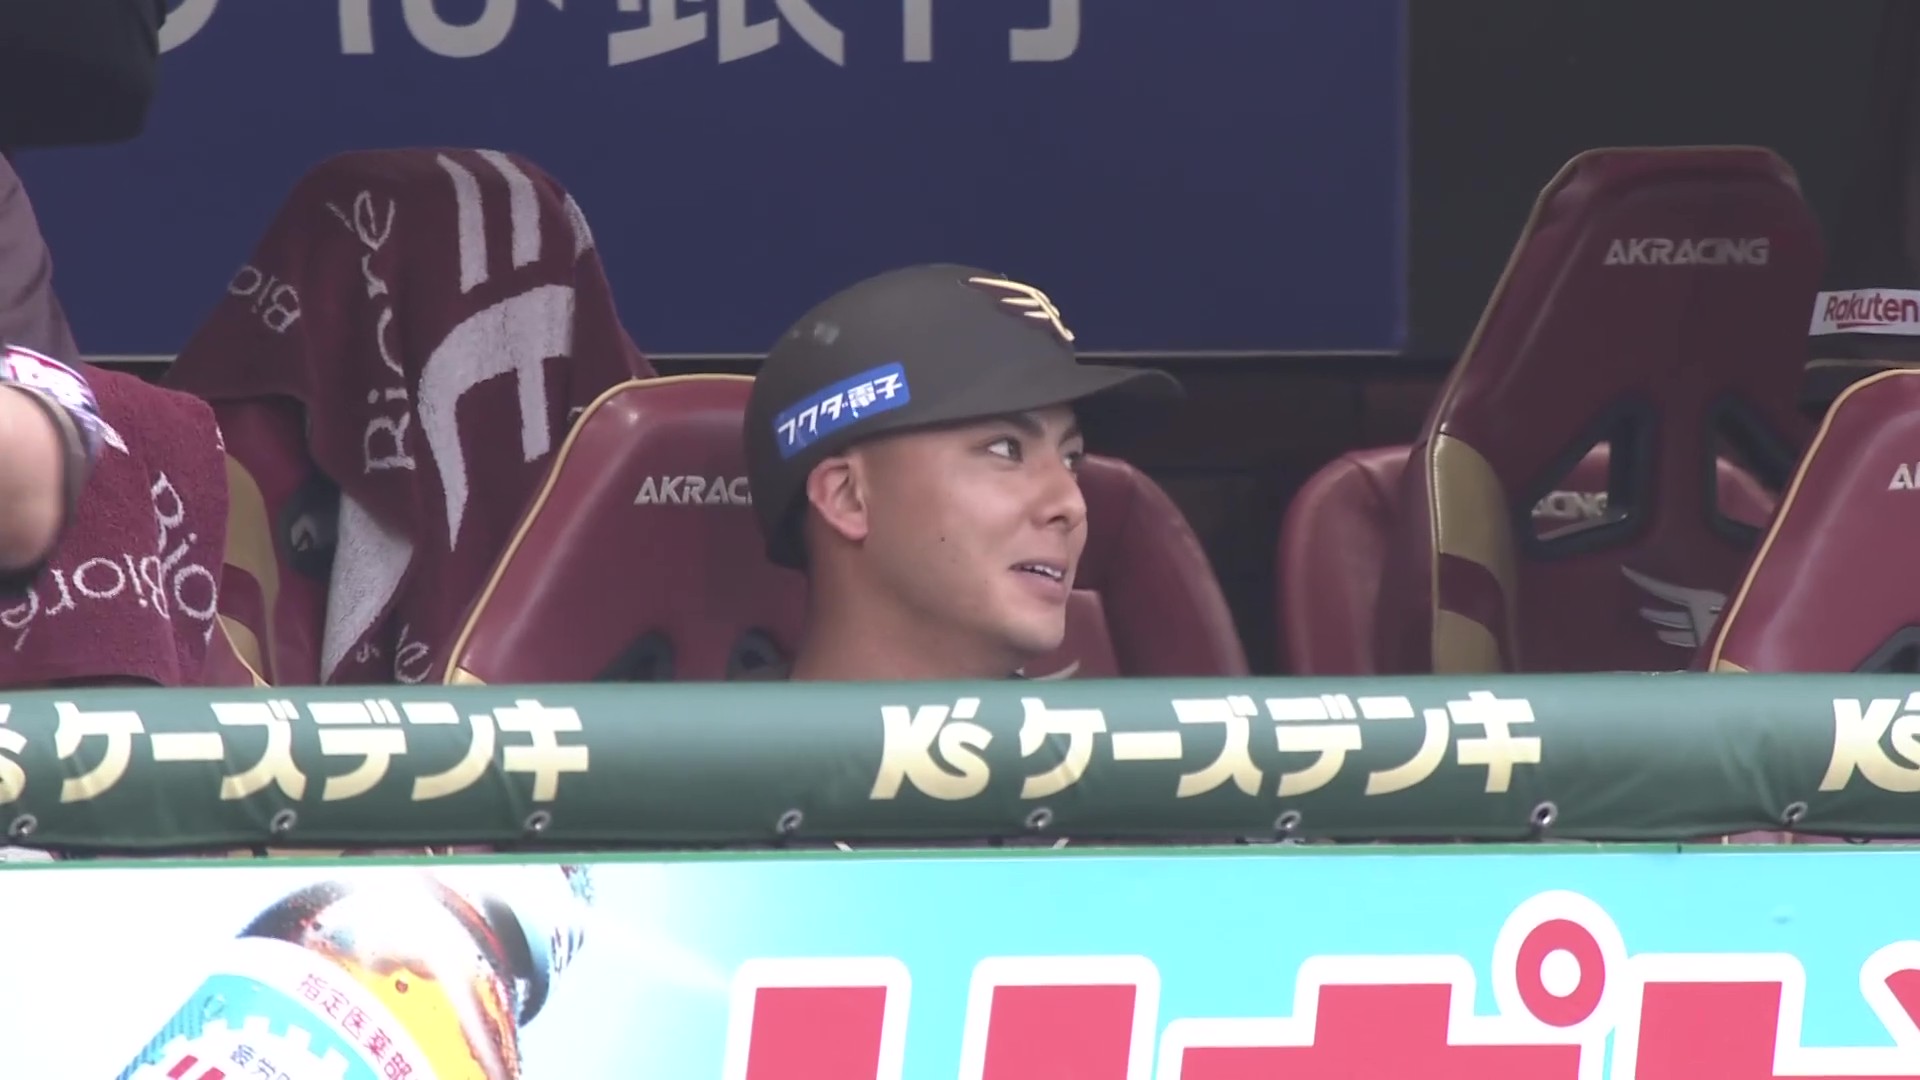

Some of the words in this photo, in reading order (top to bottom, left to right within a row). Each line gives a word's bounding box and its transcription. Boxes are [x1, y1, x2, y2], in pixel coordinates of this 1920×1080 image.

[1603, 238, 1770, 265] AKRACING
[1823, 292, 1919, 323] Rakuten
[54, 698, 589, 803] ケーズデンキ
[870, 698, 993, 800] K's
[1018, 692, 1541, 799] ケーズデンキ
